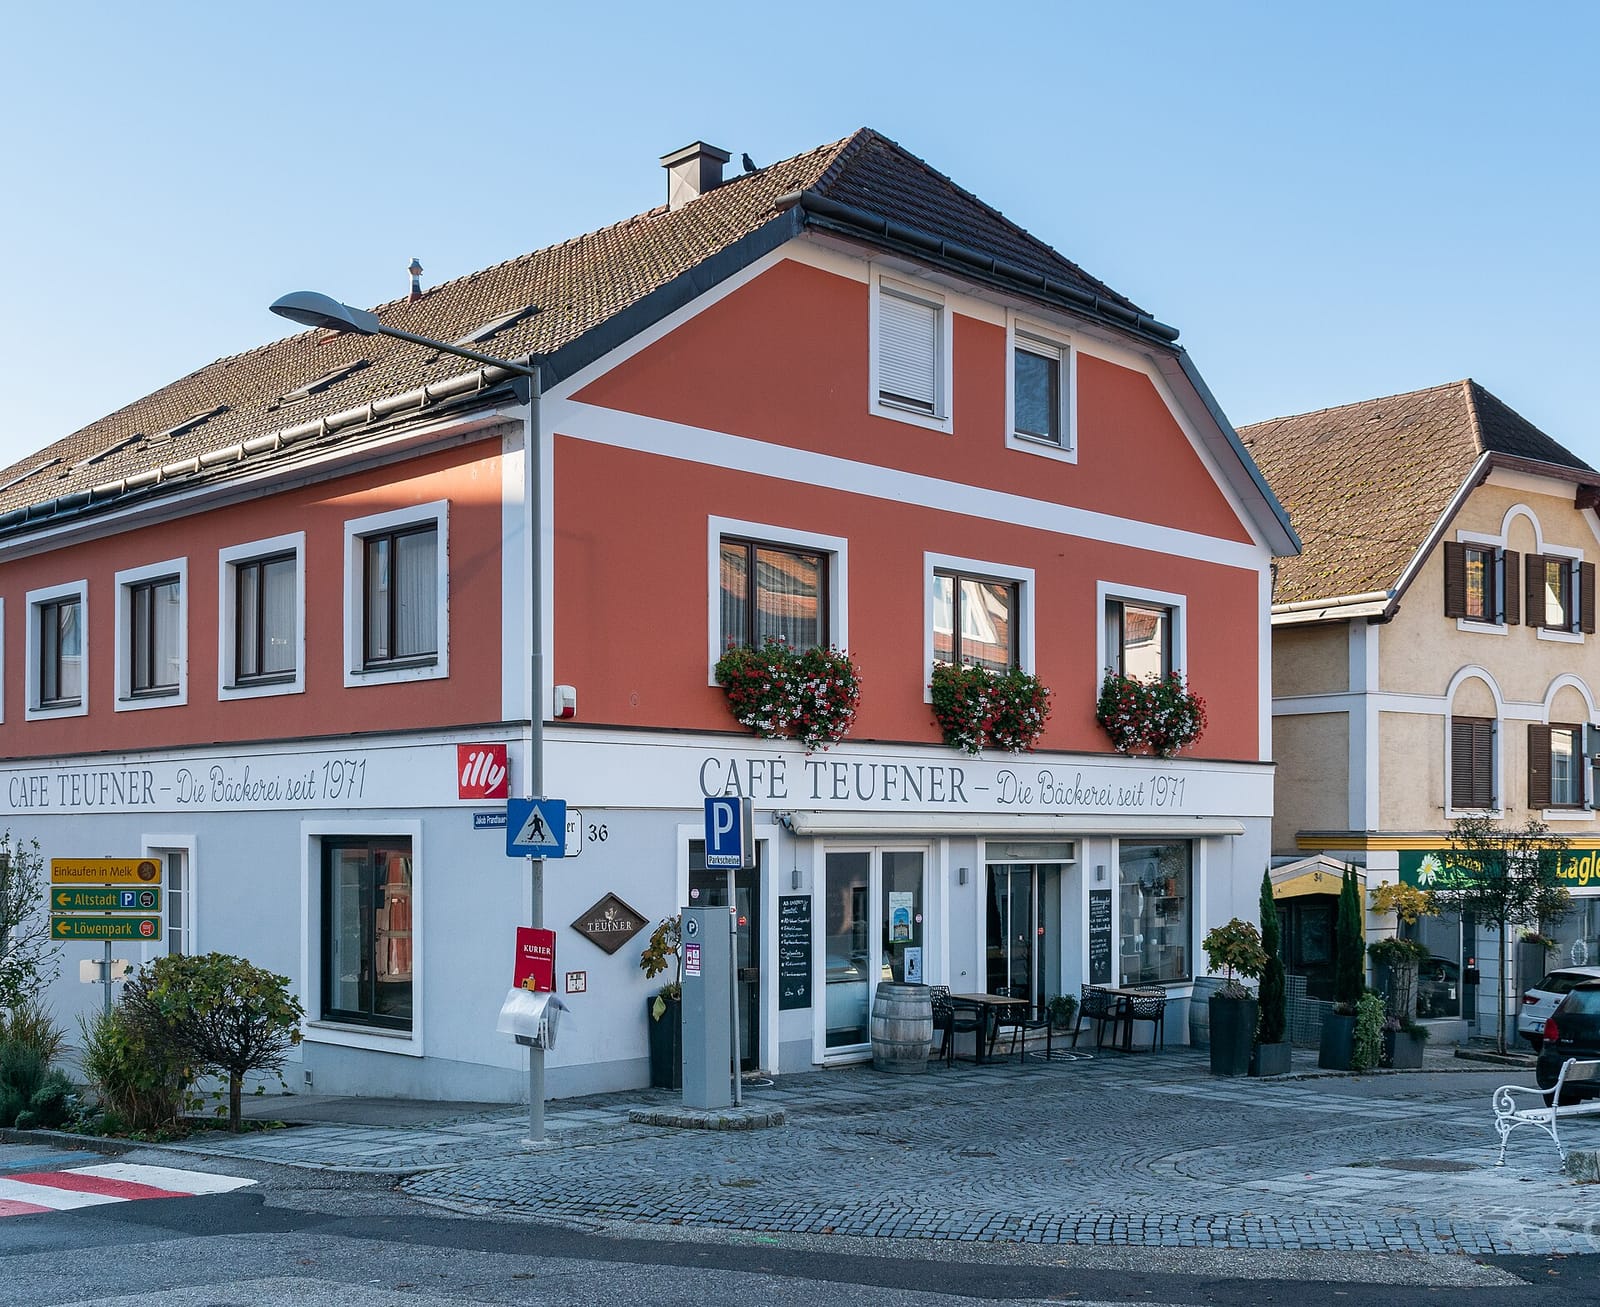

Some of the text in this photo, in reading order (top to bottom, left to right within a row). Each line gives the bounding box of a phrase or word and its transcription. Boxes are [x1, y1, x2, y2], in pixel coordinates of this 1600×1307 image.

[461, 751, 506, 795] illy
[57, 770, 156, 806] TEUFNER
[176, 768, 207, 804] Die
[210, 765, 282, 802] Bäckerei
[285, 770, 316, 801] seit
[322, 758, 367, 800] 1971
[804, 760, 969, 804] TEUFNER
[996, 769, 1034, 805] Die
[1037, 770, 1114, 806] Bäckerei
[1116, 782, 1146, 807] seit
[1149, 775, 1186, 808] 1971
[588, 824, 609, 842] 36
[713, 802, 734, 851] P
[708, 855, 740, 865] Parkscheine
[54, 866, 132, 877] Einkaufen in Melk
[75, 893, 117, 906] Altstadt
[74, 921, 132, 936] Löwenpark
[523, 944, 551, 955] KURIER
